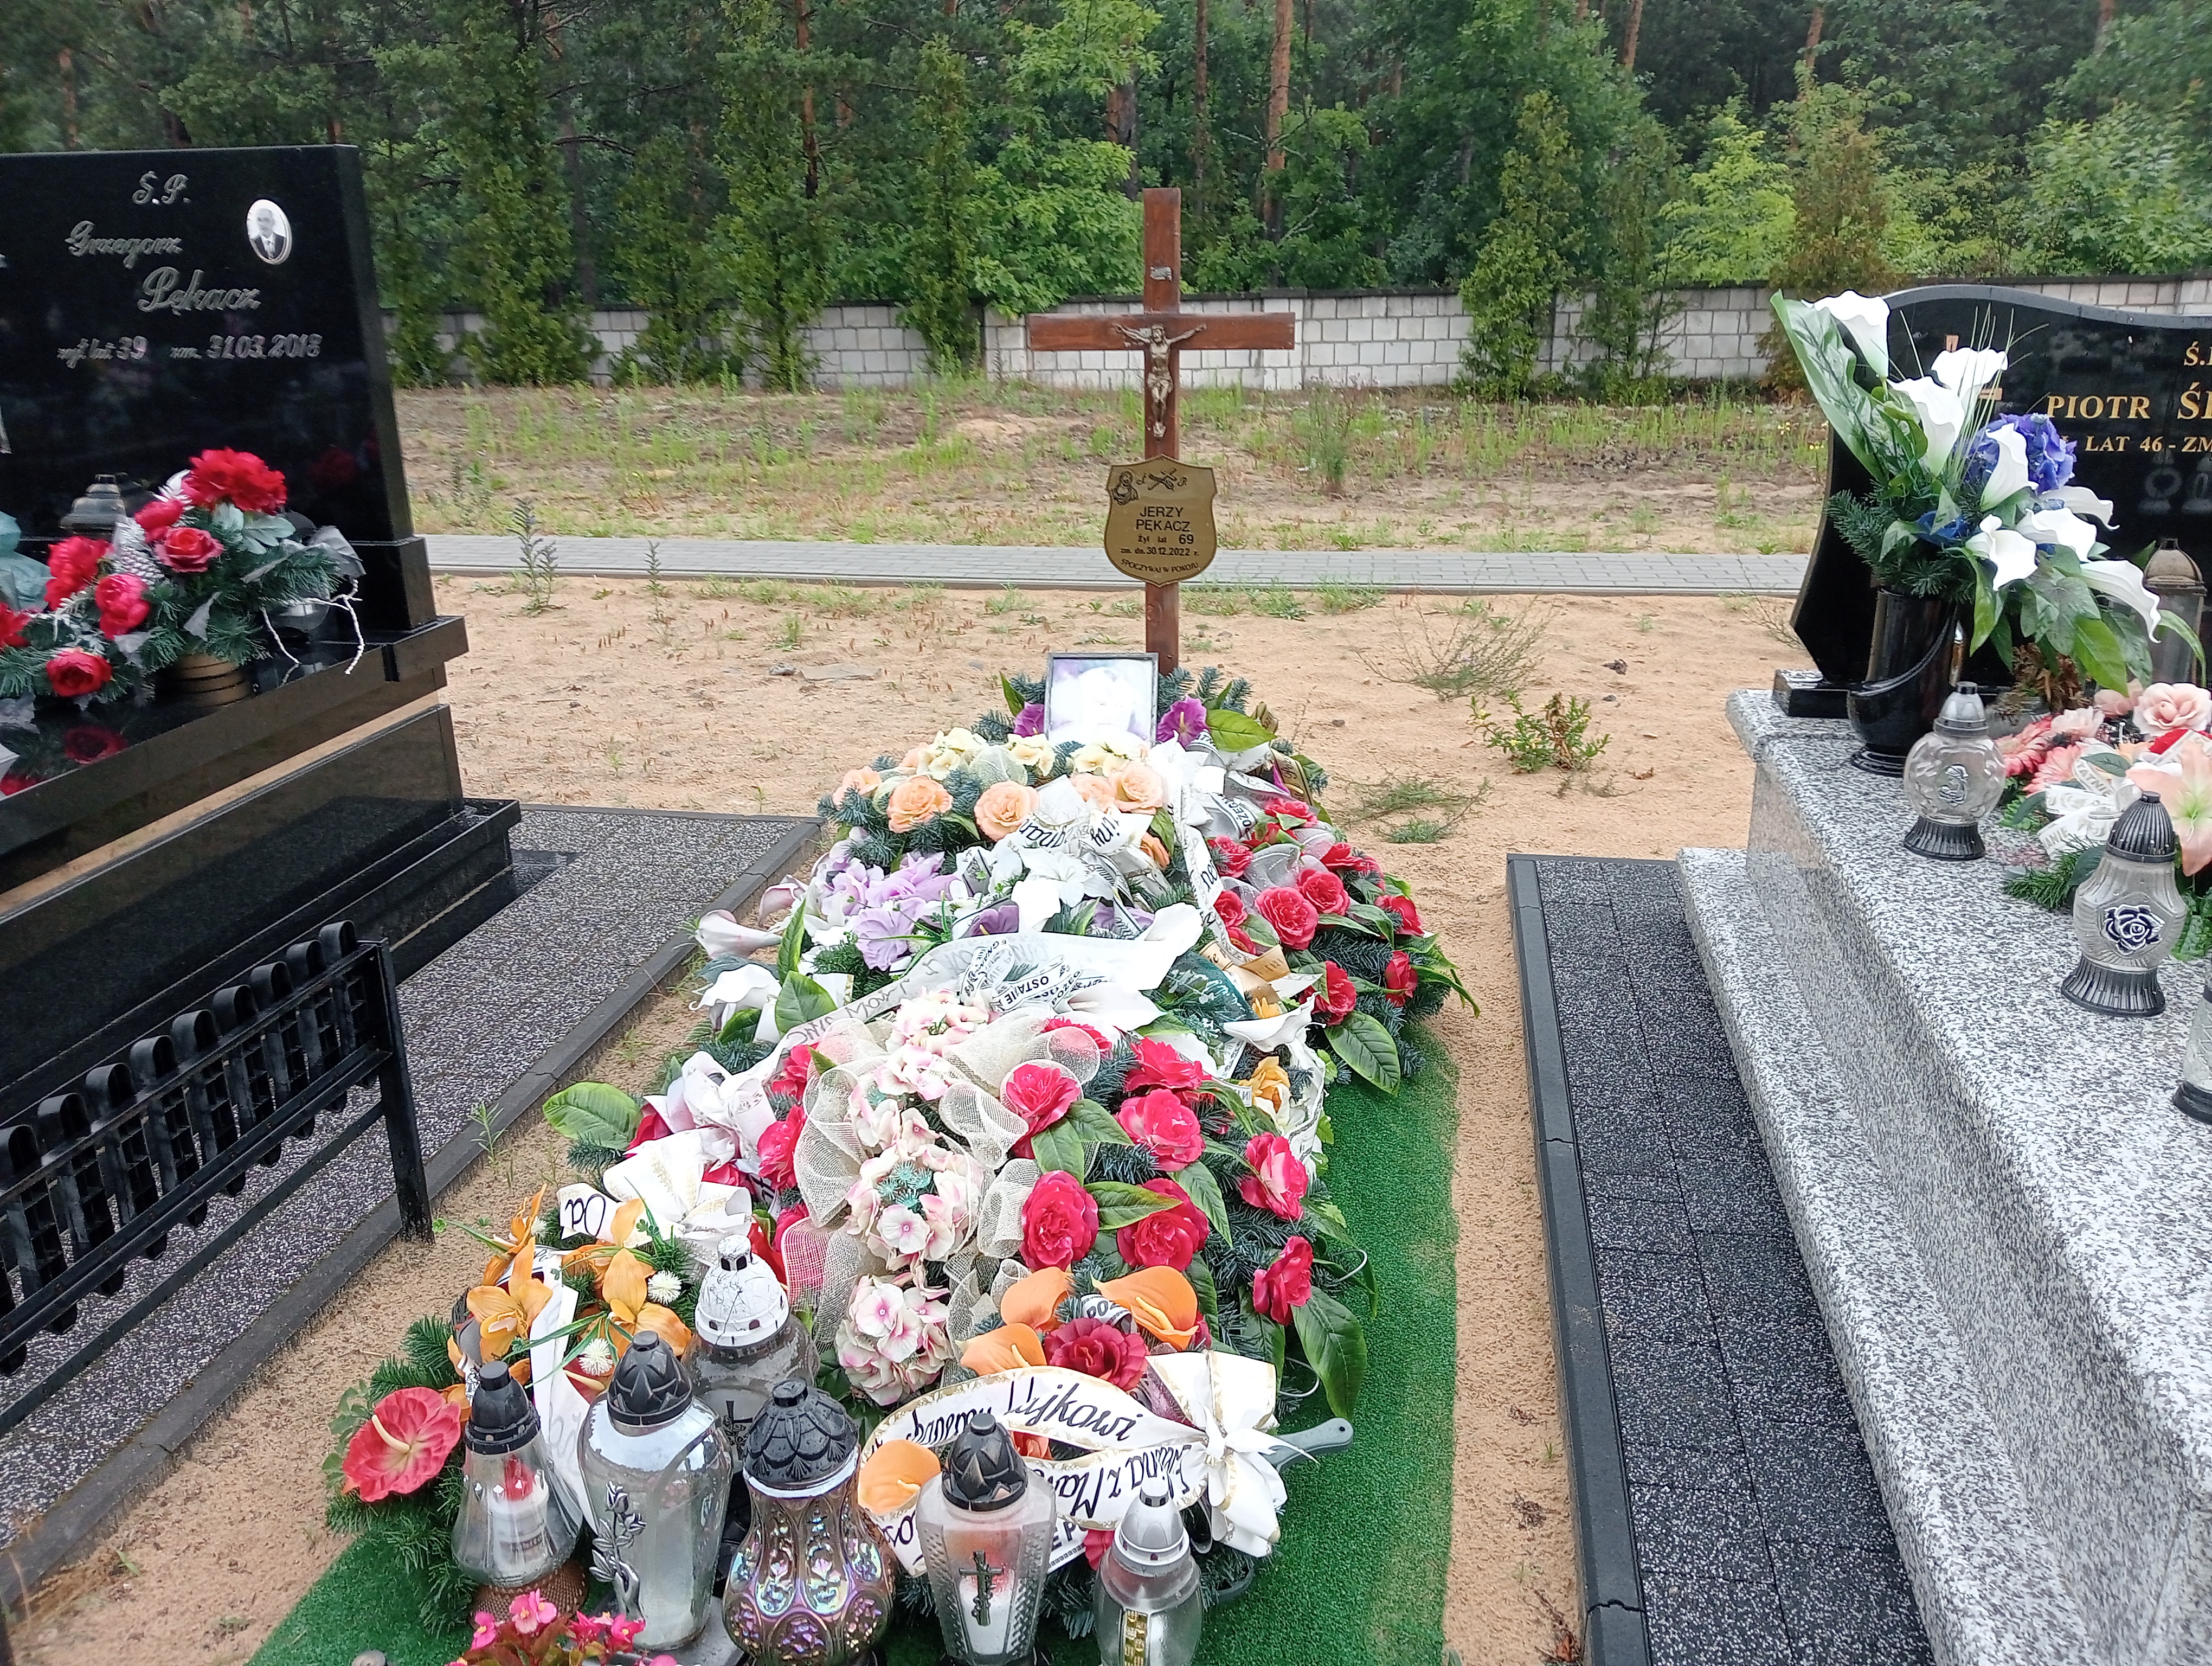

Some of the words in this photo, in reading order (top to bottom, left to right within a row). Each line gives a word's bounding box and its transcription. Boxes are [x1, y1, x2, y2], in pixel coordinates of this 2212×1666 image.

[65, 220, 183, 269] Grzegorz
[137, 266, 261, 316] Pękacz
[116, 335, 149, 360] 39
[2046, 395, 2151, 419] PIOTR
[2085, 435, 2131, 452] LAT
[2139, 436, 2164, 452] 46
[1140, 506, 1184, 518] JERZY
[1136, 519, 1191, 532] PĘKACZ
[1179, 534, 1194, 544] 69
[1171, 561, 1199, 573] POKOJU
